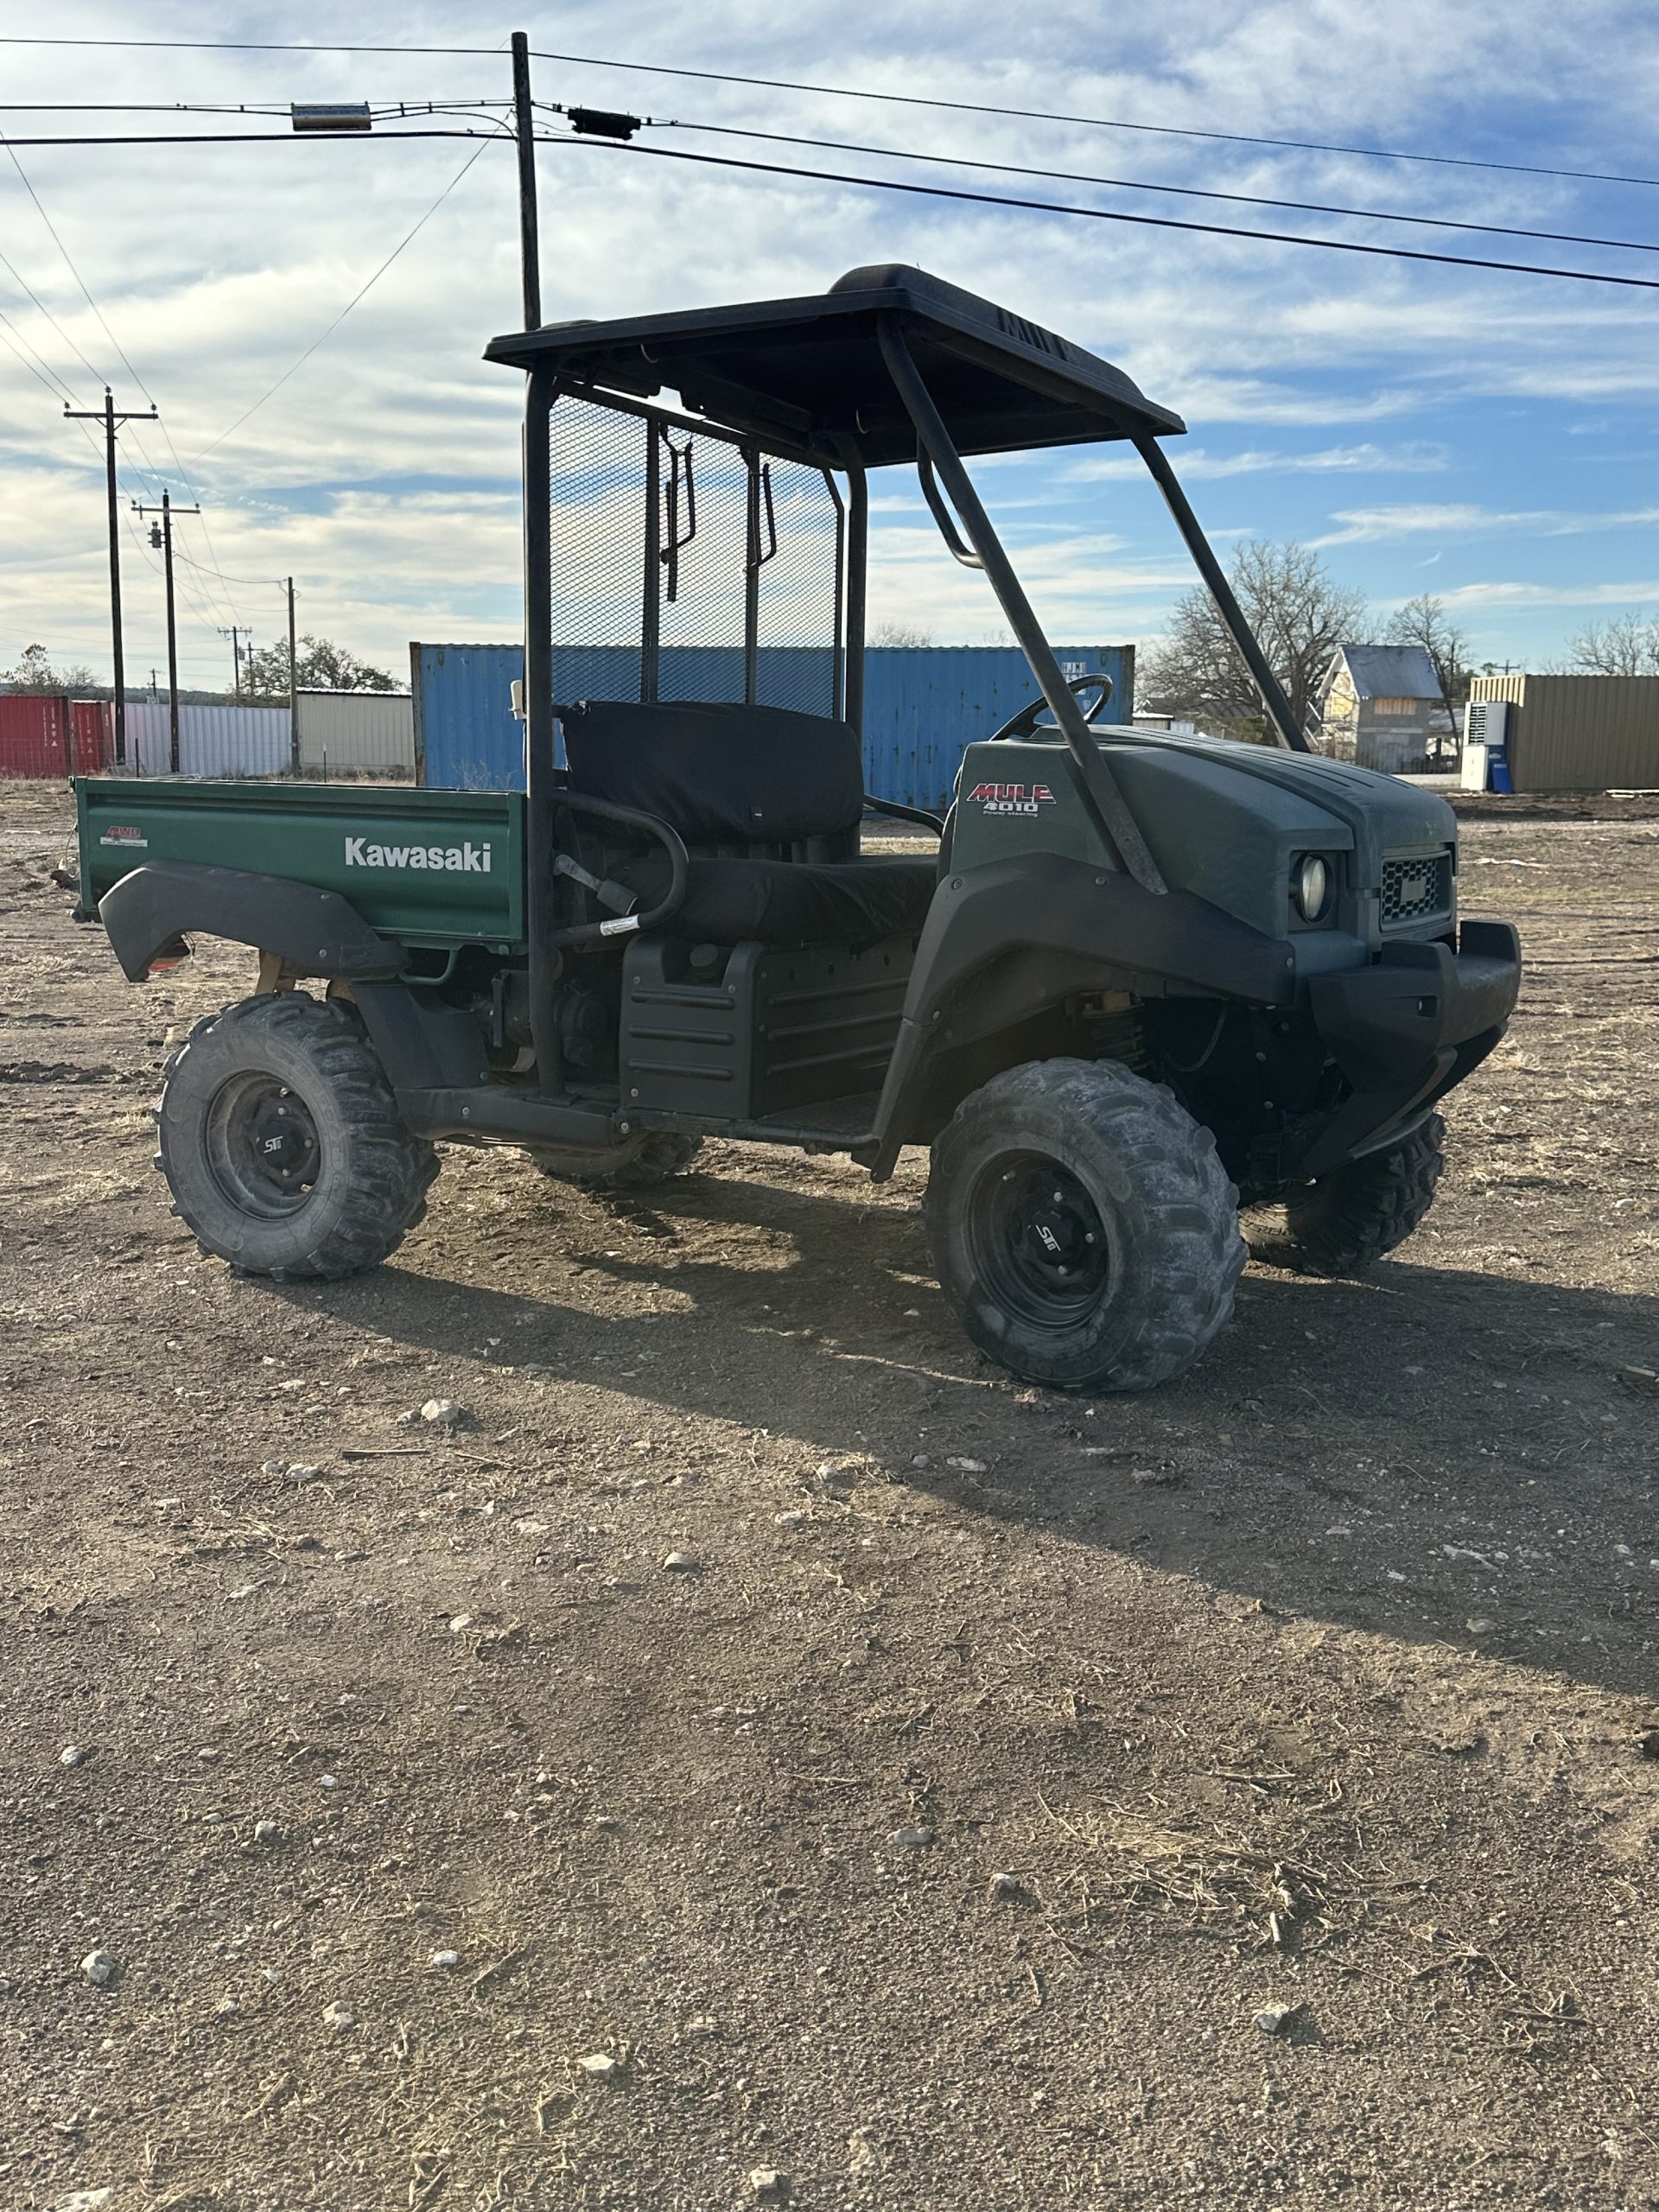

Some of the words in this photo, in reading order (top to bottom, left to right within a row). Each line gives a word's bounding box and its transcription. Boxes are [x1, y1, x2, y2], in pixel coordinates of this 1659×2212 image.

[966, 783, 1057, 804] MULE
[983, 802, 1039, 812] 4010
[345, 836, 491, 873] Kawasaki
